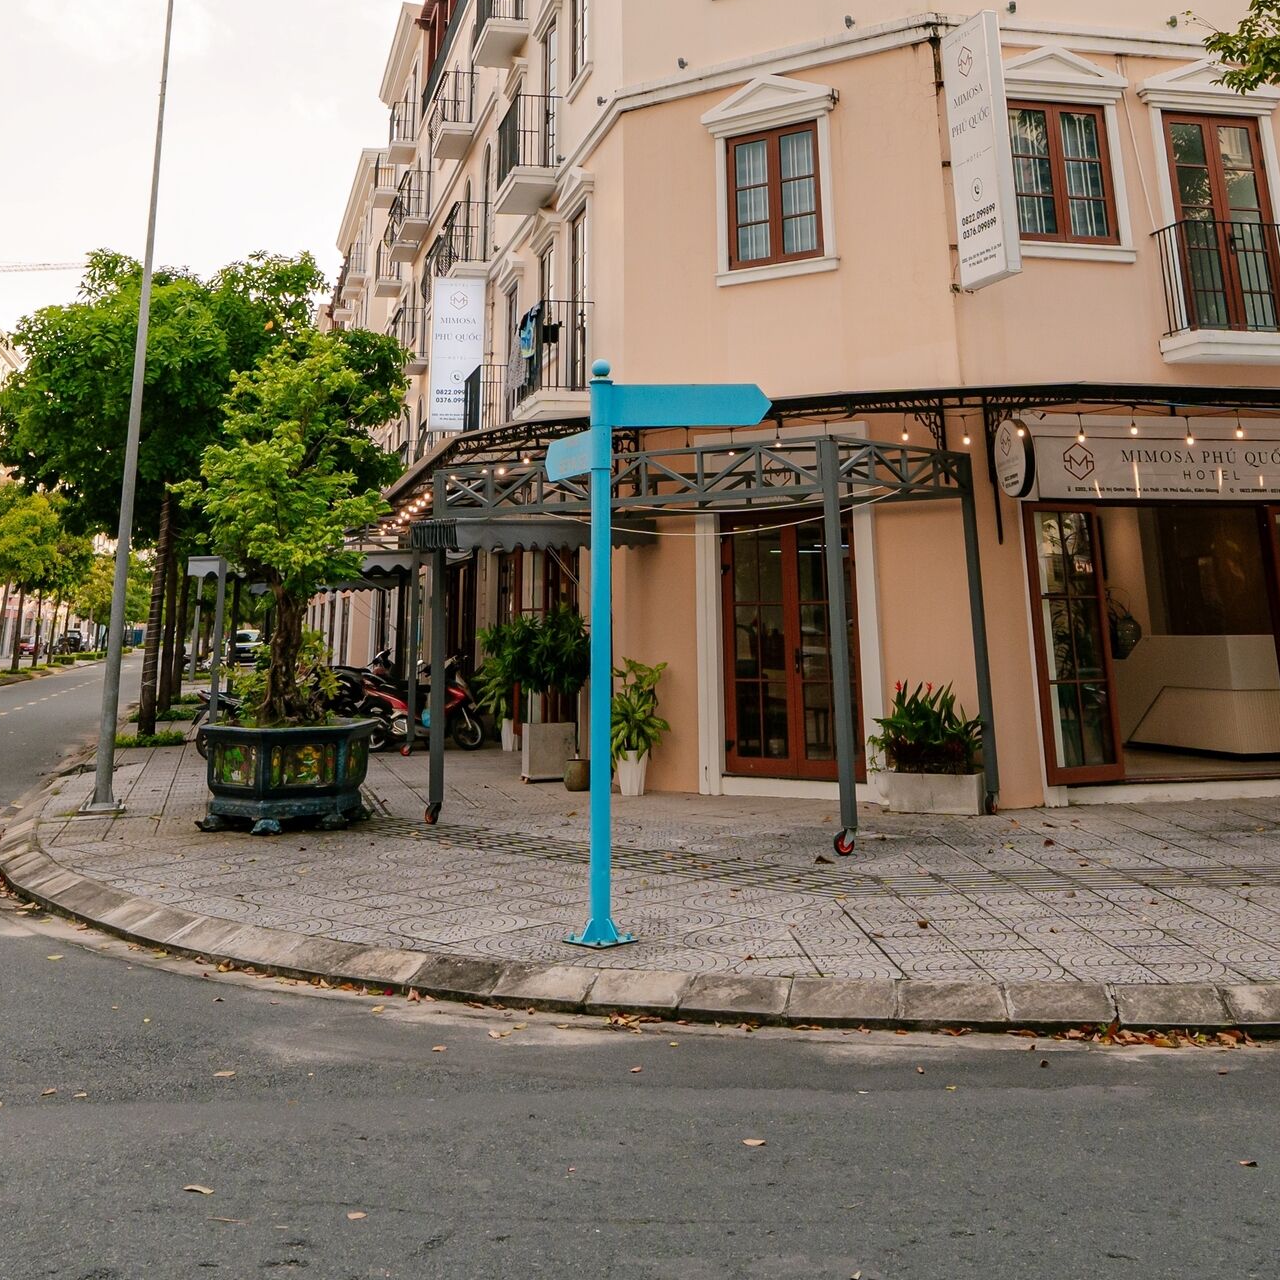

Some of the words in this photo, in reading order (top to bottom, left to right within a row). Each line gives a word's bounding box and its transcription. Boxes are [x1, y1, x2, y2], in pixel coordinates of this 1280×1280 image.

[953, 83, 984, 109] MIMOSA
[951, 118, 968, 138] PHÚ
[968, 105, 990, 129] QUỐC
[440, 317, 477, 325] MIMOSA
[1121, 449, 1197, 464] MIMOSA
[1202, 447, 1238, 465] PHÚ
[1183, 469, 1241, 481] HOTEL
